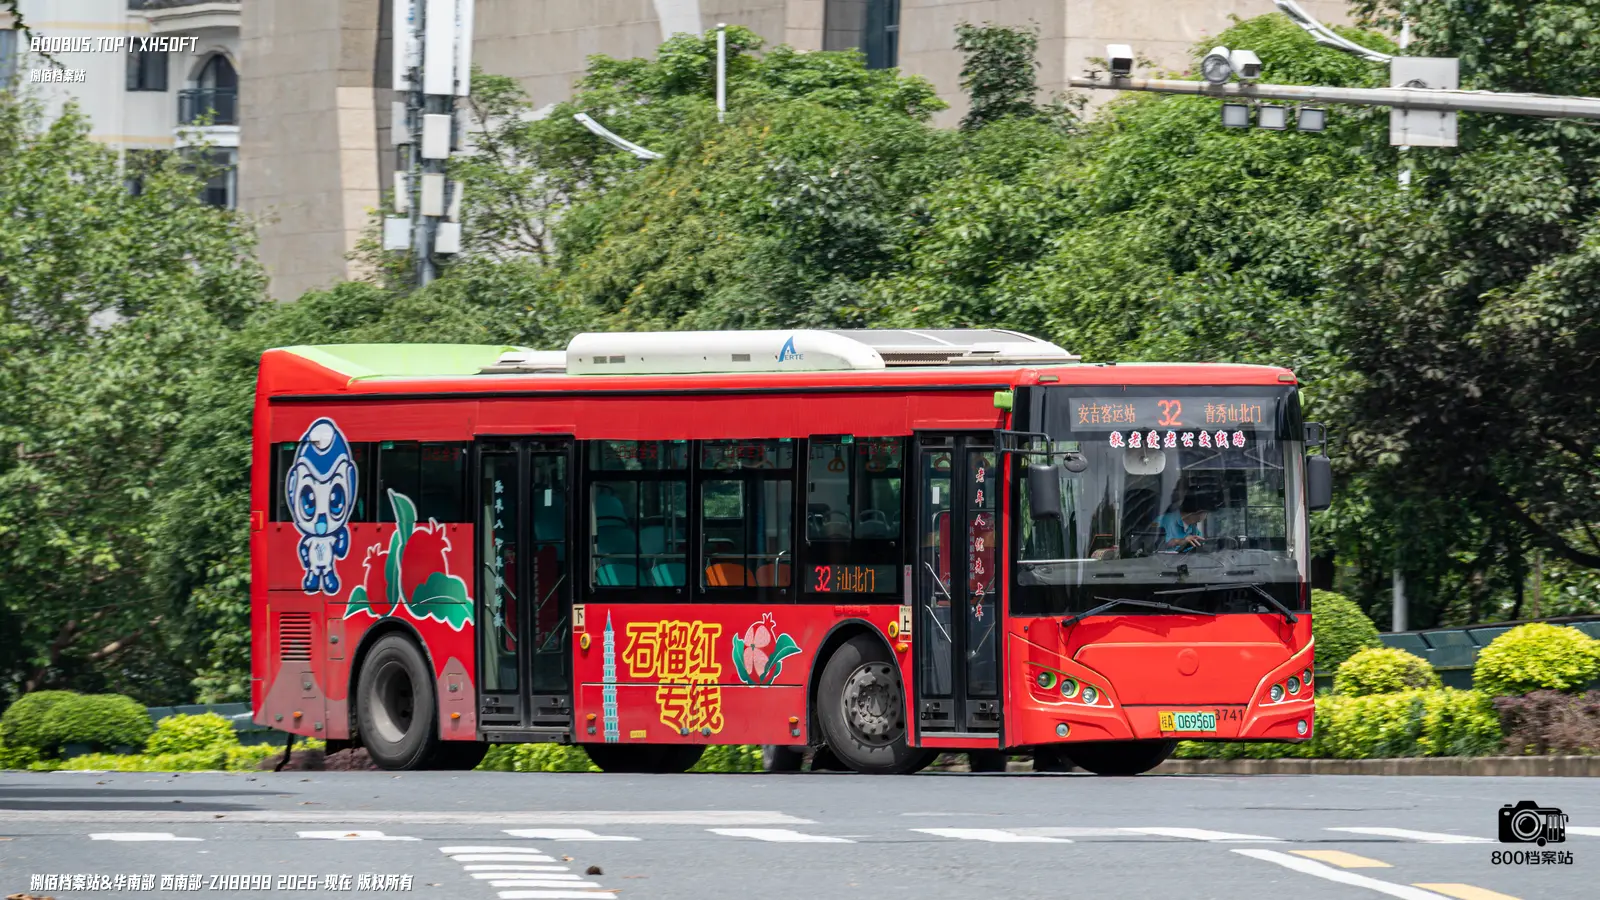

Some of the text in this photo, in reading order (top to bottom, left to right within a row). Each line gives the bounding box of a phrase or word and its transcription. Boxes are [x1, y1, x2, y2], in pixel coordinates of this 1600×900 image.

[1078, 400, 1262, 427] 安吉客运站 32 青秀山北门
[1109, 430, 1246, 449] 敬老爱老公交线路
[974, 467, 986, 622] 老年人优先上车
[814, 566, 831, 592] 32
[573, 607, 584, 624] 下
[900, 615, 911, 632] 上
[622, 620, 722, 678] 石榴红
[656, 677, 724, 734] 专线
[1178, 714, 1216, 729] 06956D
